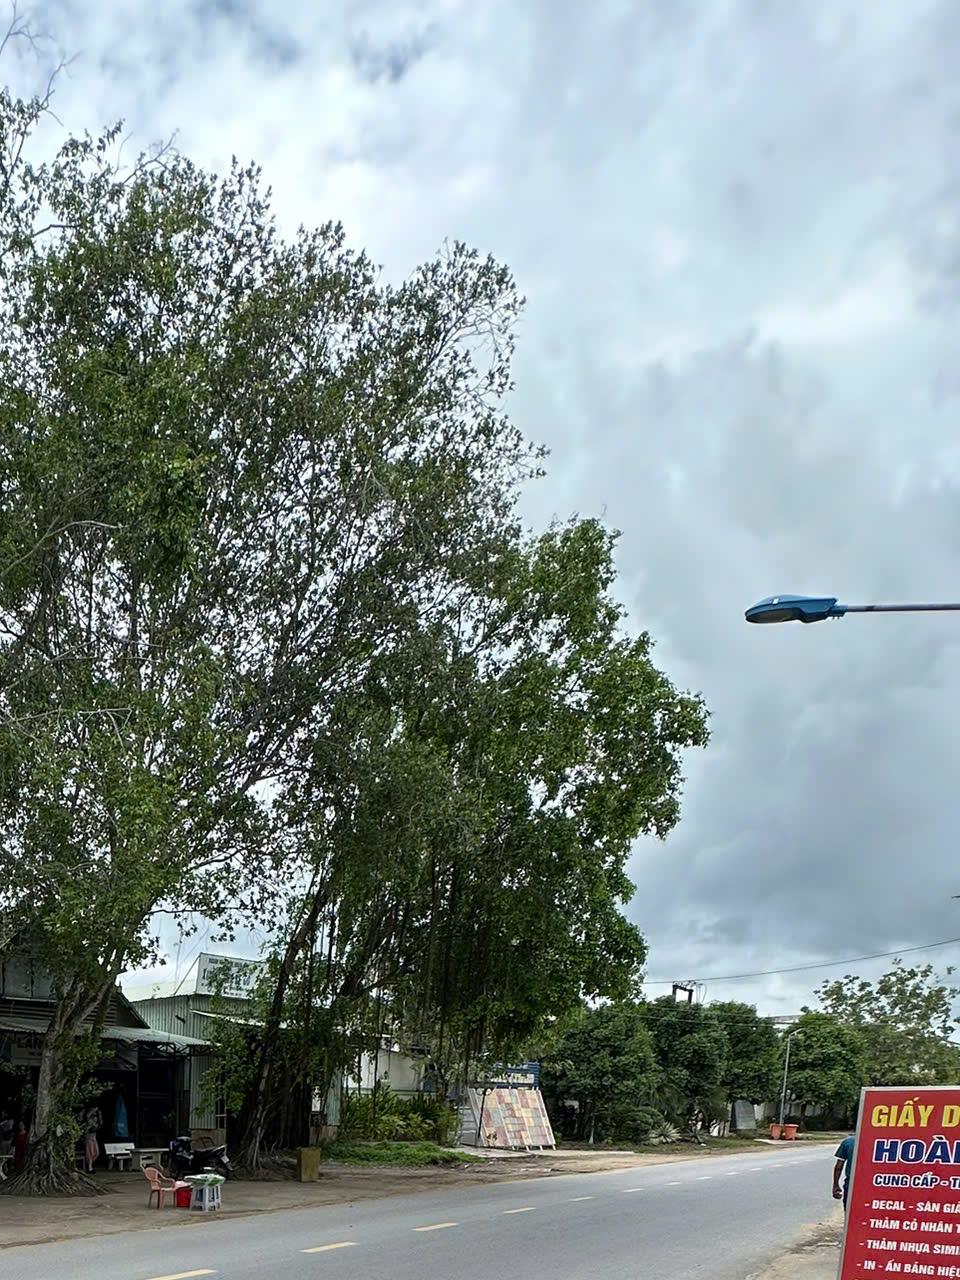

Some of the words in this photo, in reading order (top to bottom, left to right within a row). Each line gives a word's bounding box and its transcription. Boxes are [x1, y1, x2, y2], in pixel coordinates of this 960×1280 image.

[871, 1097, 934, 1127] GIẤY
[873, 1174, 910, 1187] CUNG
[911, 1171, 940, 1188] CẤP
[951, 1177, 960, 1189] T
[872, 1200, 906, 1211] DECAL
[863, 1260, 876, 1270] IN
[904, 1262, 934, 1275] BẢNG
